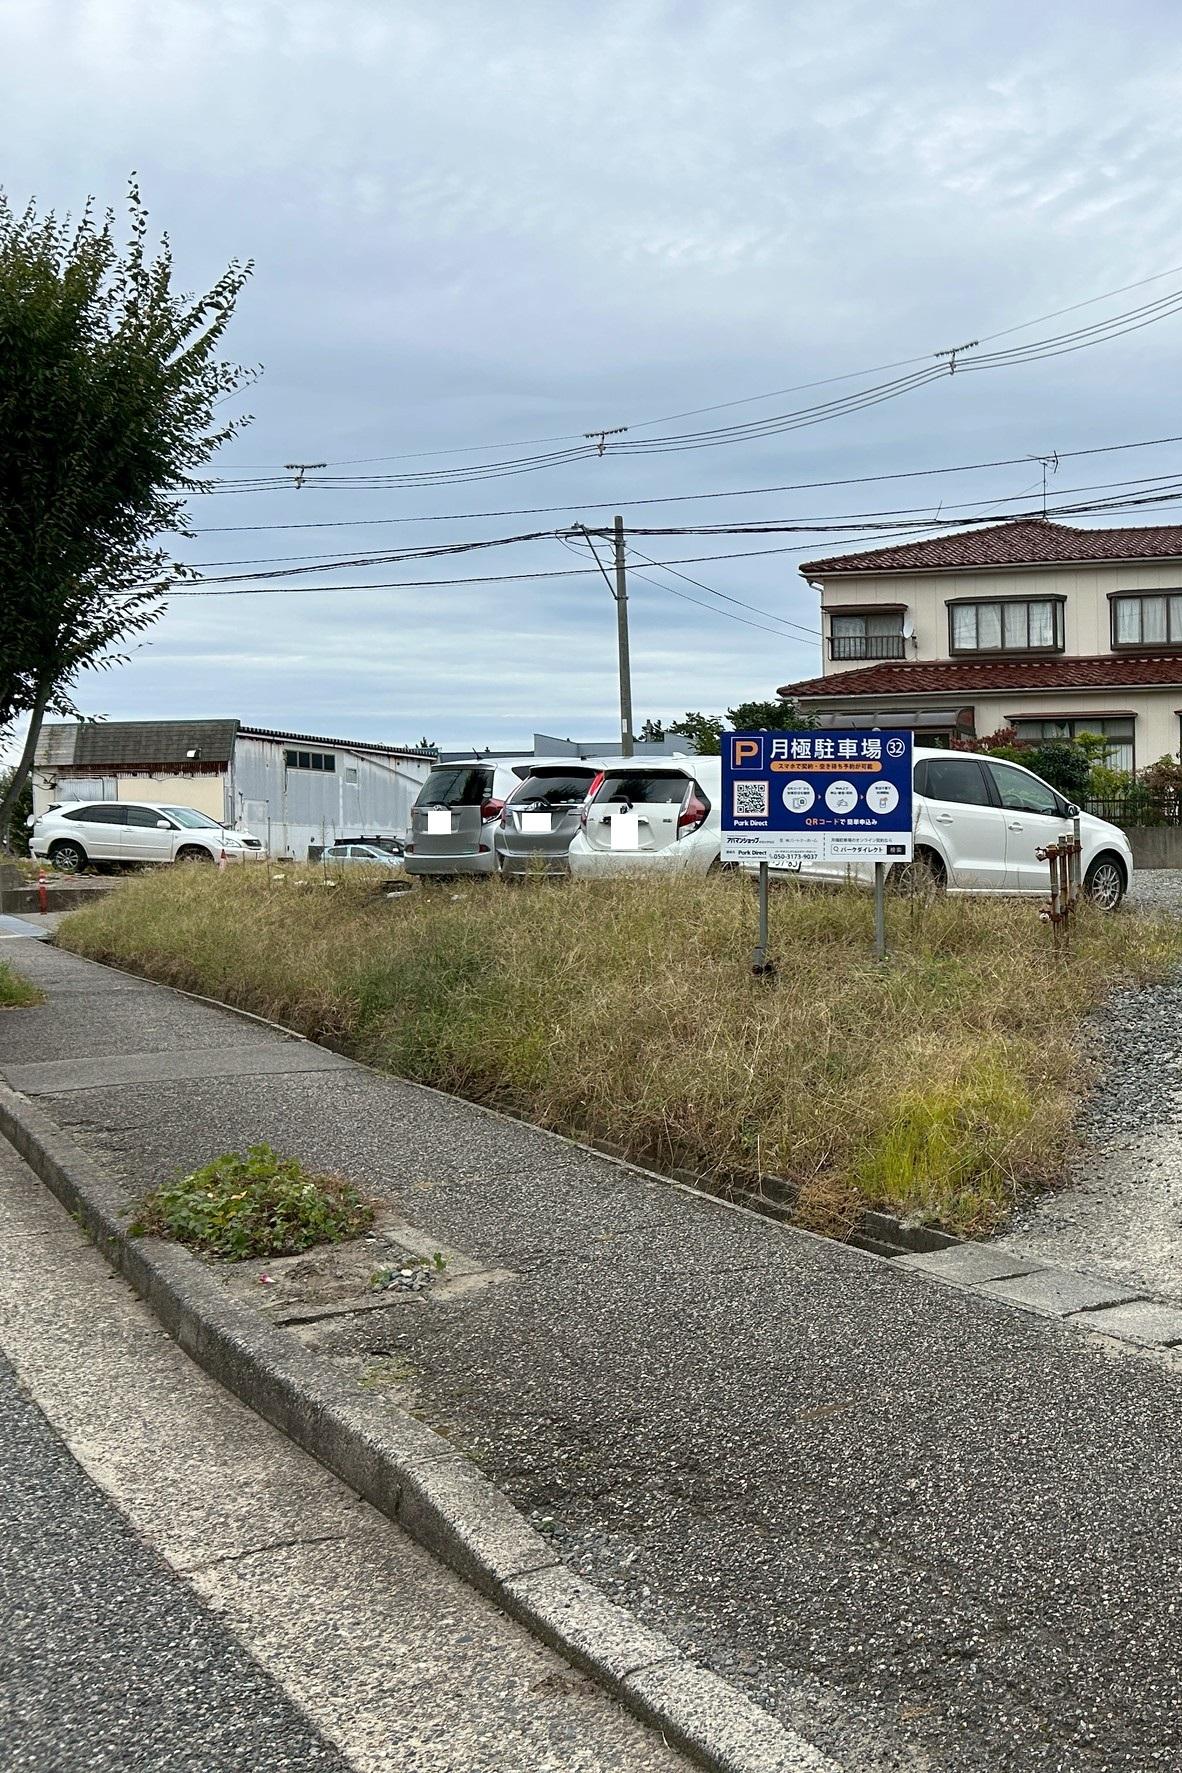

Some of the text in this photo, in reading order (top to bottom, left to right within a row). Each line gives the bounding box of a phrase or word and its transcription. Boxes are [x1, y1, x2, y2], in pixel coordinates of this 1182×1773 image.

[735, 741, 758, 766] P
[770, 738, 882, 760] 月極駐車場
[805, 818, 878, 826] QRコードで簡単申込み
